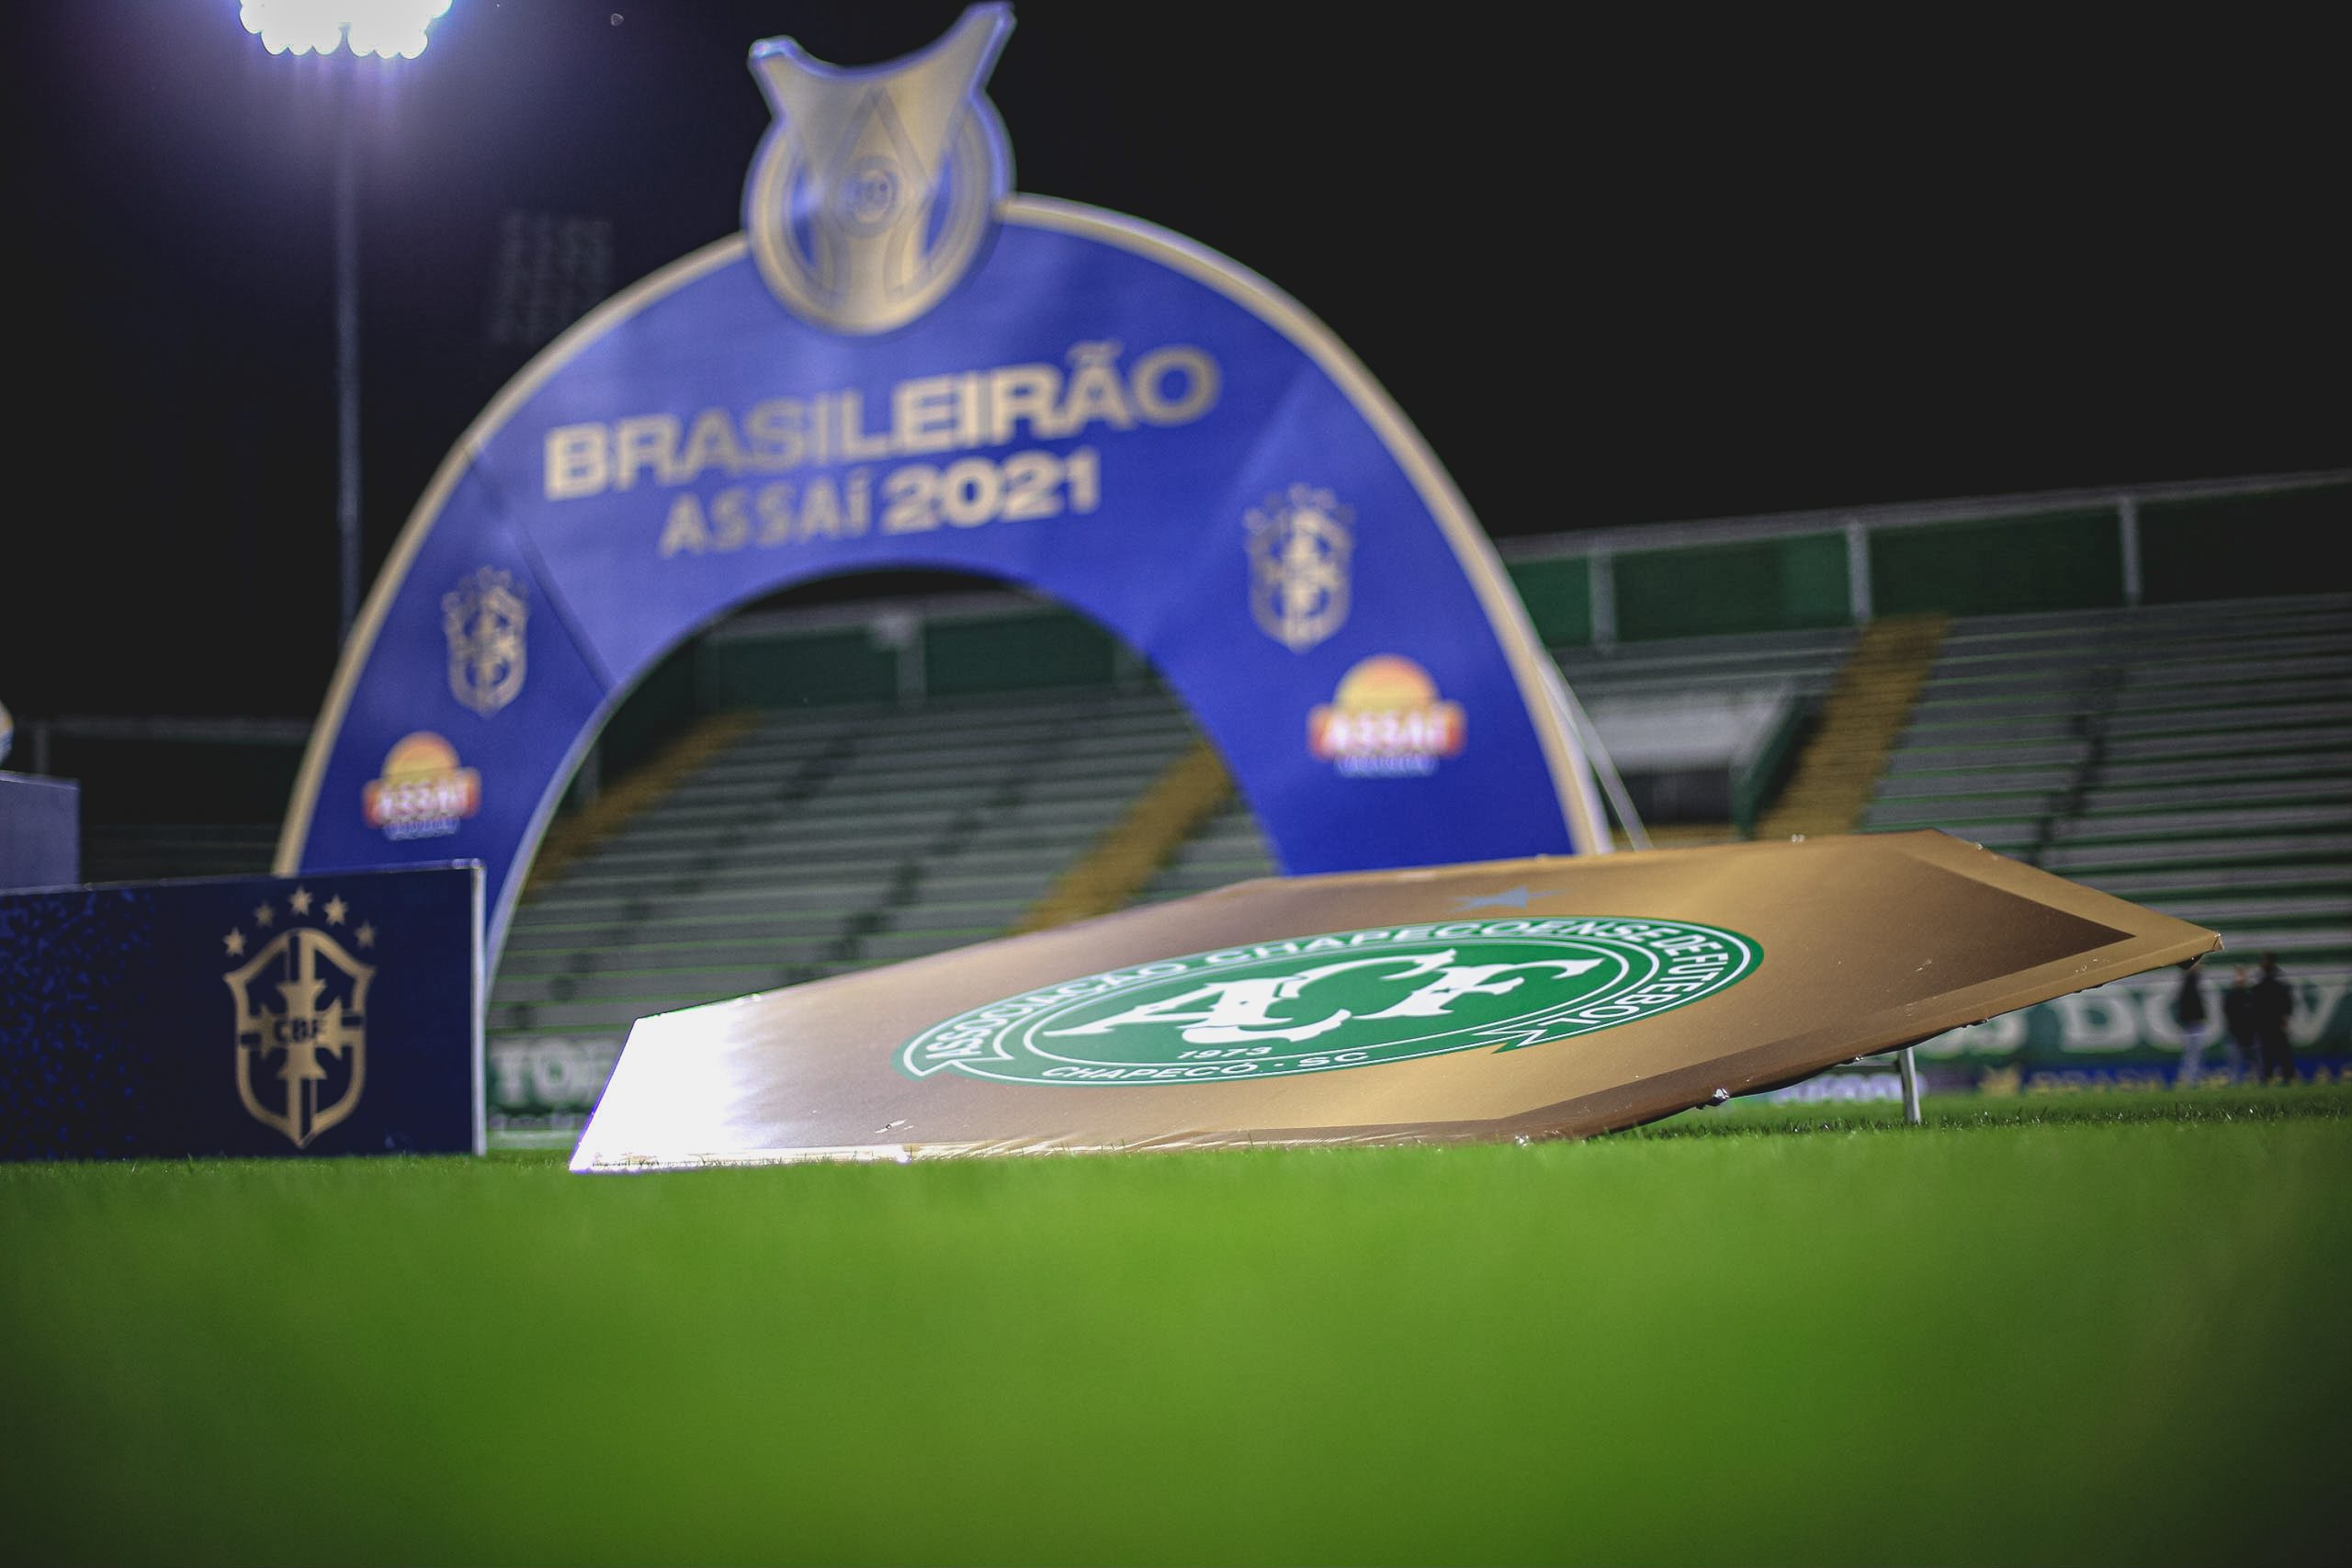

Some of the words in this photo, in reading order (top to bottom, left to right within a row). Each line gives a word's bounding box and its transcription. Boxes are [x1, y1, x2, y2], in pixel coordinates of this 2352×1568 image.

[544, 340, 1221, 502] BRASILEIRÃO
[659, 467, 873, 558] ASSAÍ
[882, 447, 1102, 536] 2021
[925, 963, 1188, 1059] ASSOCIAÇÃO
[1205, 920, 1681, 964] CHAPECOENSE
[1537, 953, 1729, 1026] FUTEBOL
[274, 1018, 323, 1043] CBF
[1177, 1046, 1272, 1059] 1973
[1042, 1061, 1259, 1079] CHAPECÓ
[1297, 1052, 1369, 1067] SC
